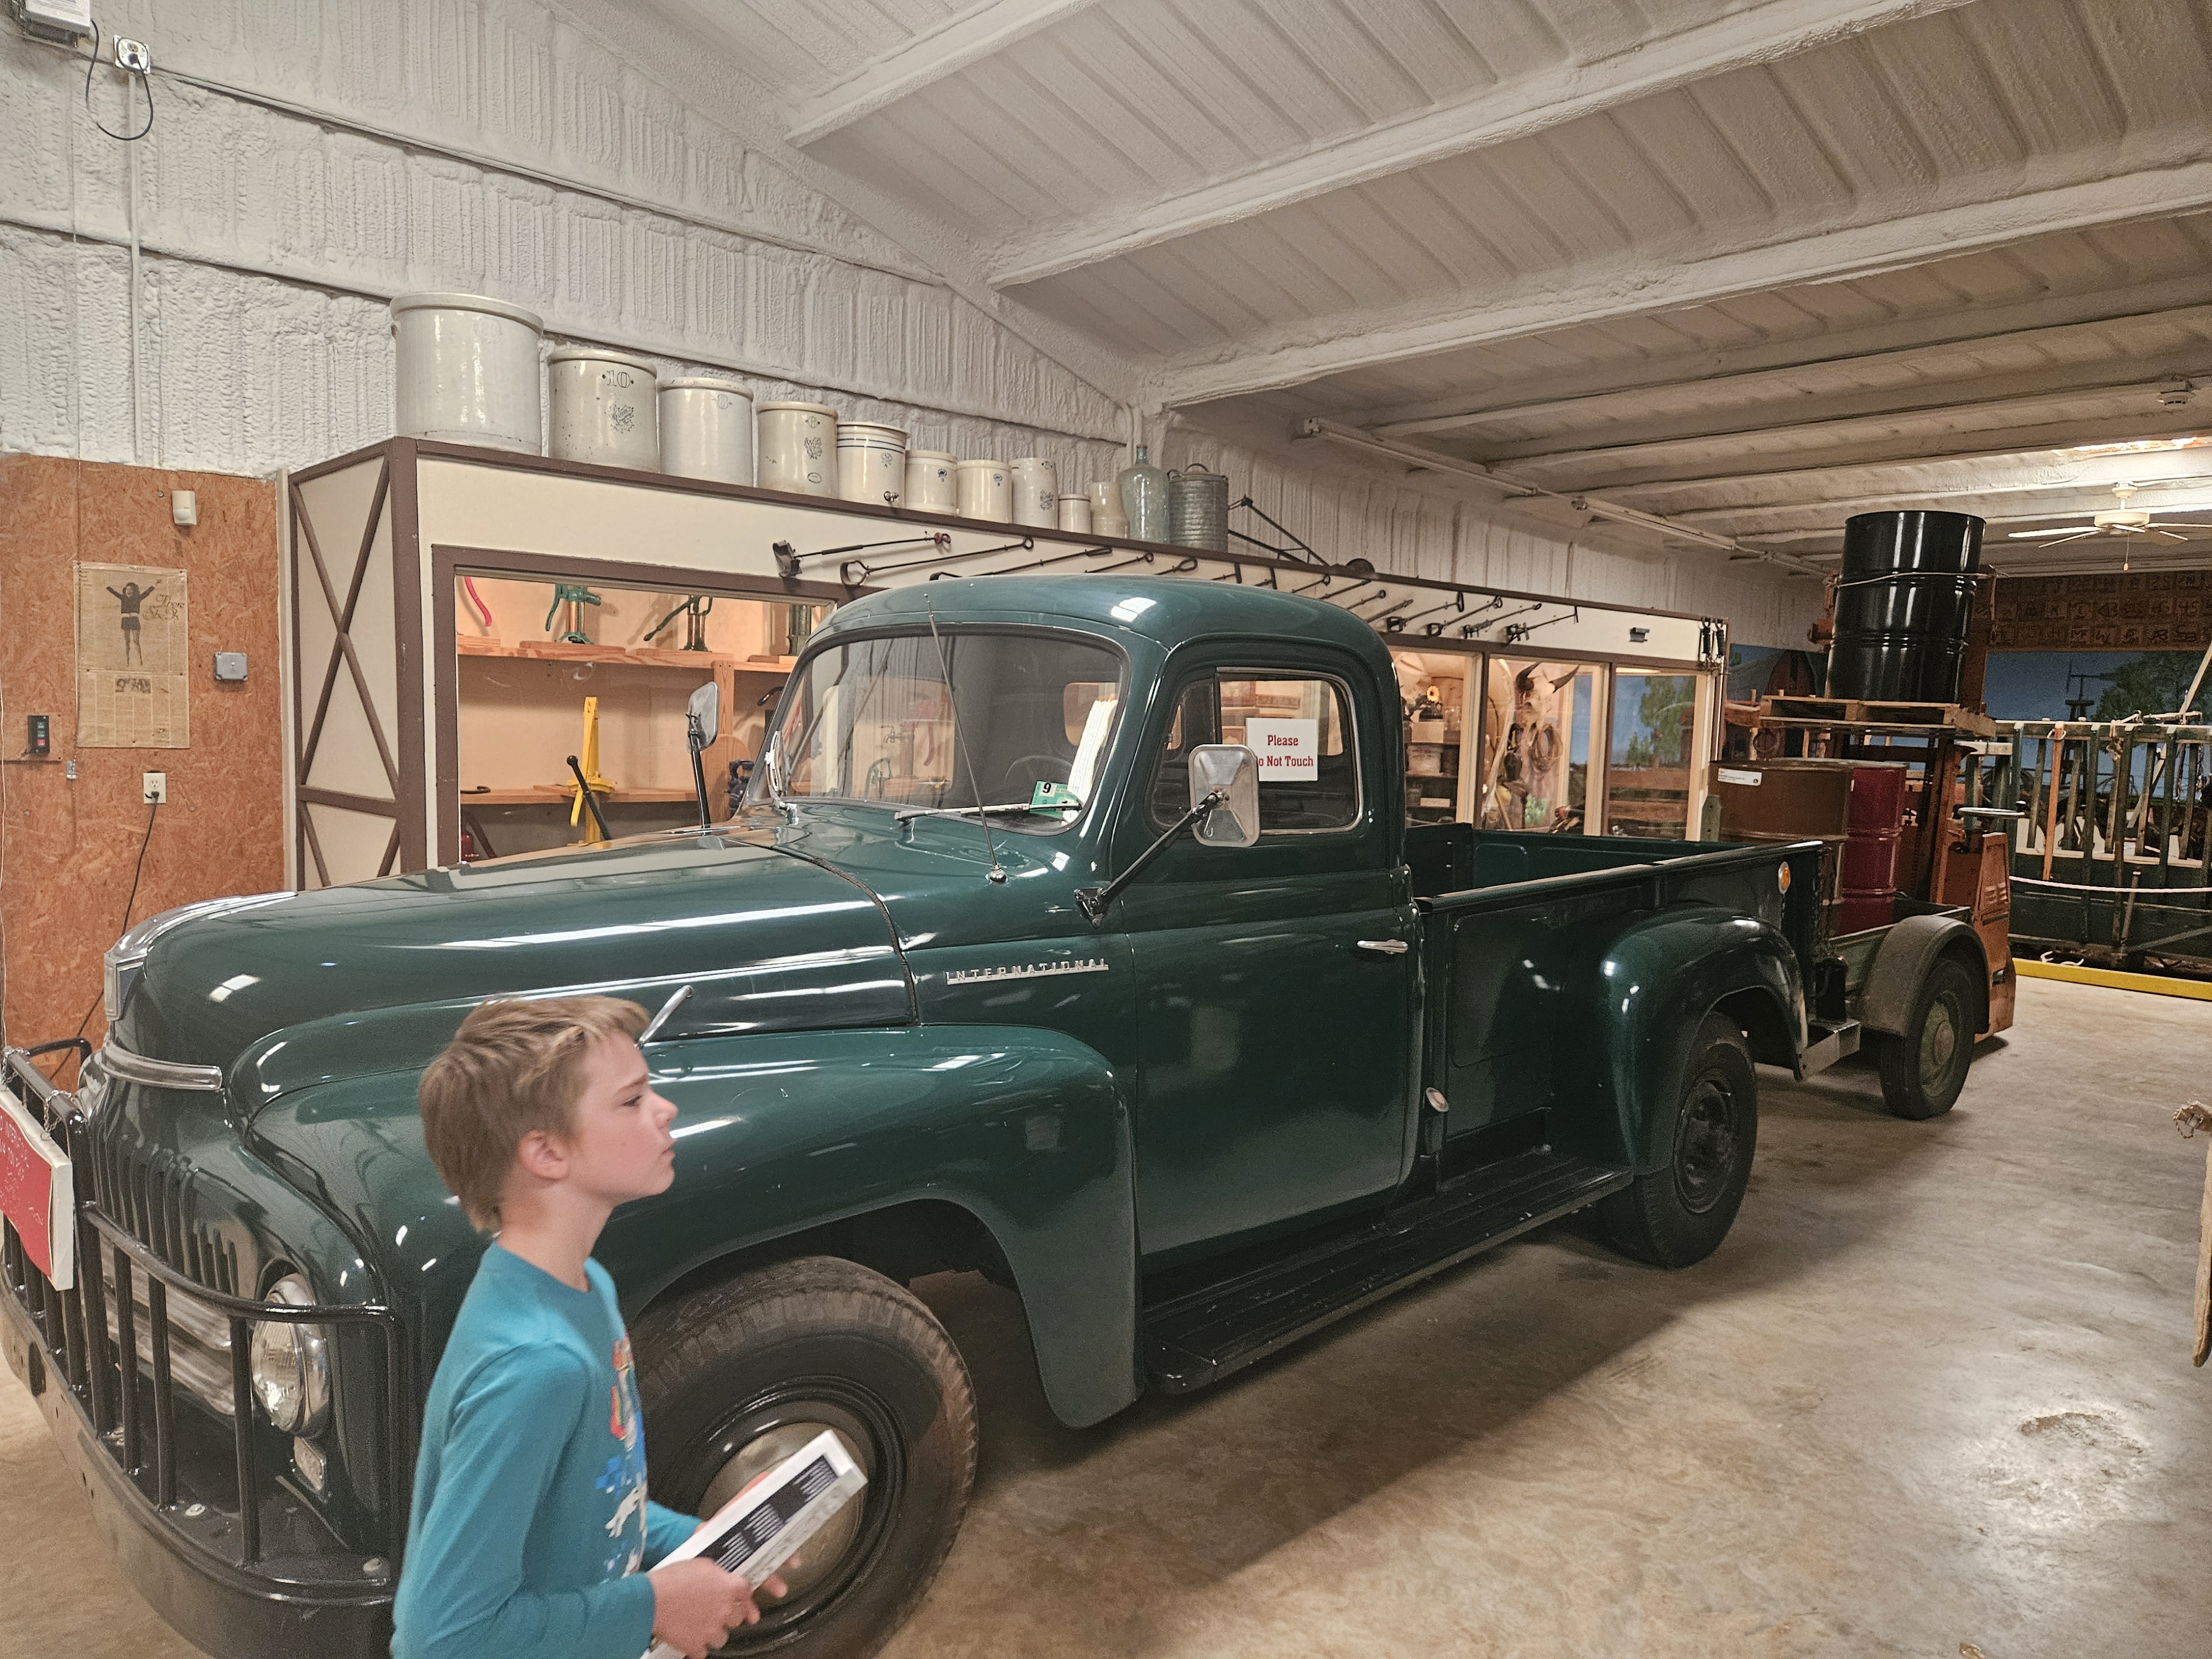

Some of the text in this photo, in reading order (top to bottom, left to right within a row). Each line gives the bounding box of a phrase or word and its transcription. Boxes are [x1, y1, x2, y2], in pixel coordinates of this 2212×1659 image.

[607, 370, 630, 388] 10
[717, 394, 728, 409] 8
[1267, 735, 1298, 745] Please
[1257, 755, 1313, 766] o Not Touch
[1042, 782, 1052, 794] 9
[946, 958, 1108, 982] INTERNATIONAL
